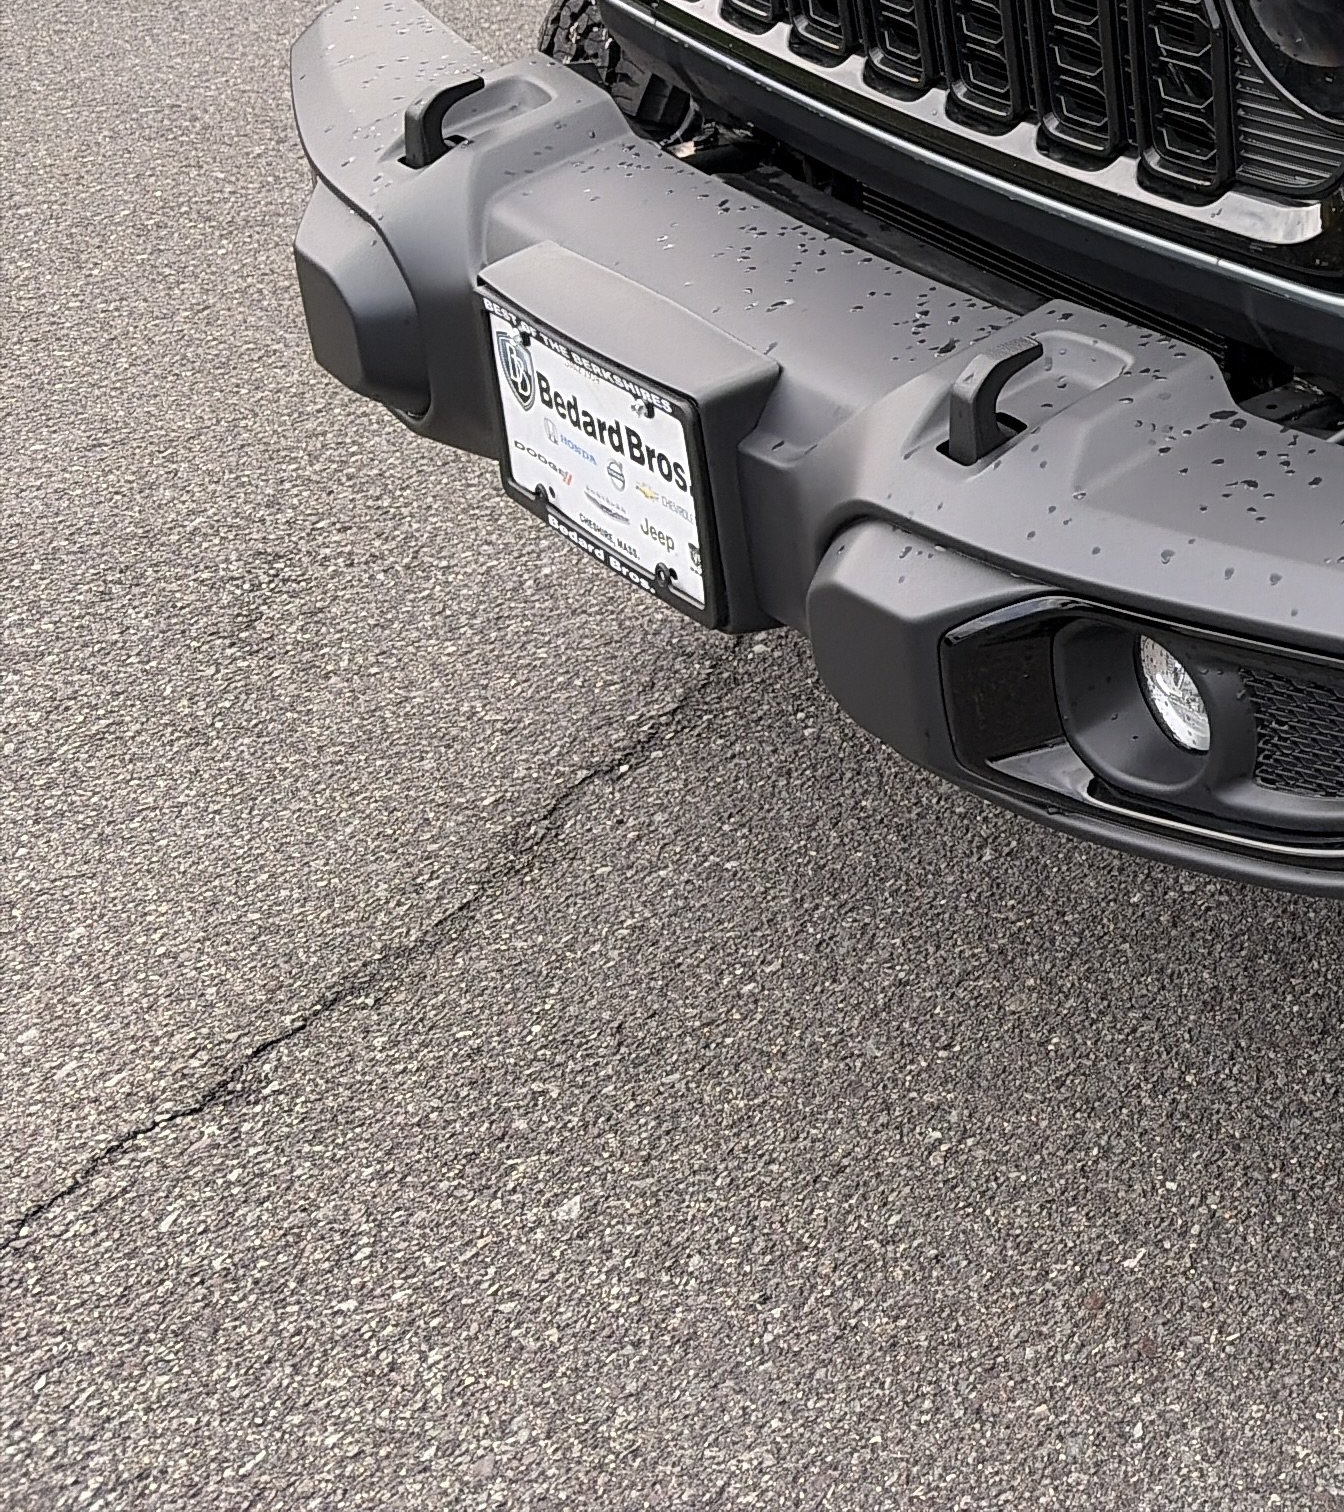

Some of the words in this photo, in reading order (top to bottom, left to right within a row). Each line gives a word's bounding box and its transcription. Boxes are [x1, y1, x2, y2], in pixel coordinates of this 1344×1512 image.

[483, 297, 517, 326] BEST
[520, 322, 538, 337] OF
[540, 333, 571, 359] THE
[571, 352, 673, 414] BERKSHIRES
[514, 439, 568, 479] DODGE
[560, 433, 598, 466] HONDA
[548, 513, 605, 562] Bedard
[609, 555, 656, 594] Bros.
[639, 517, 675, 553] Jeep
